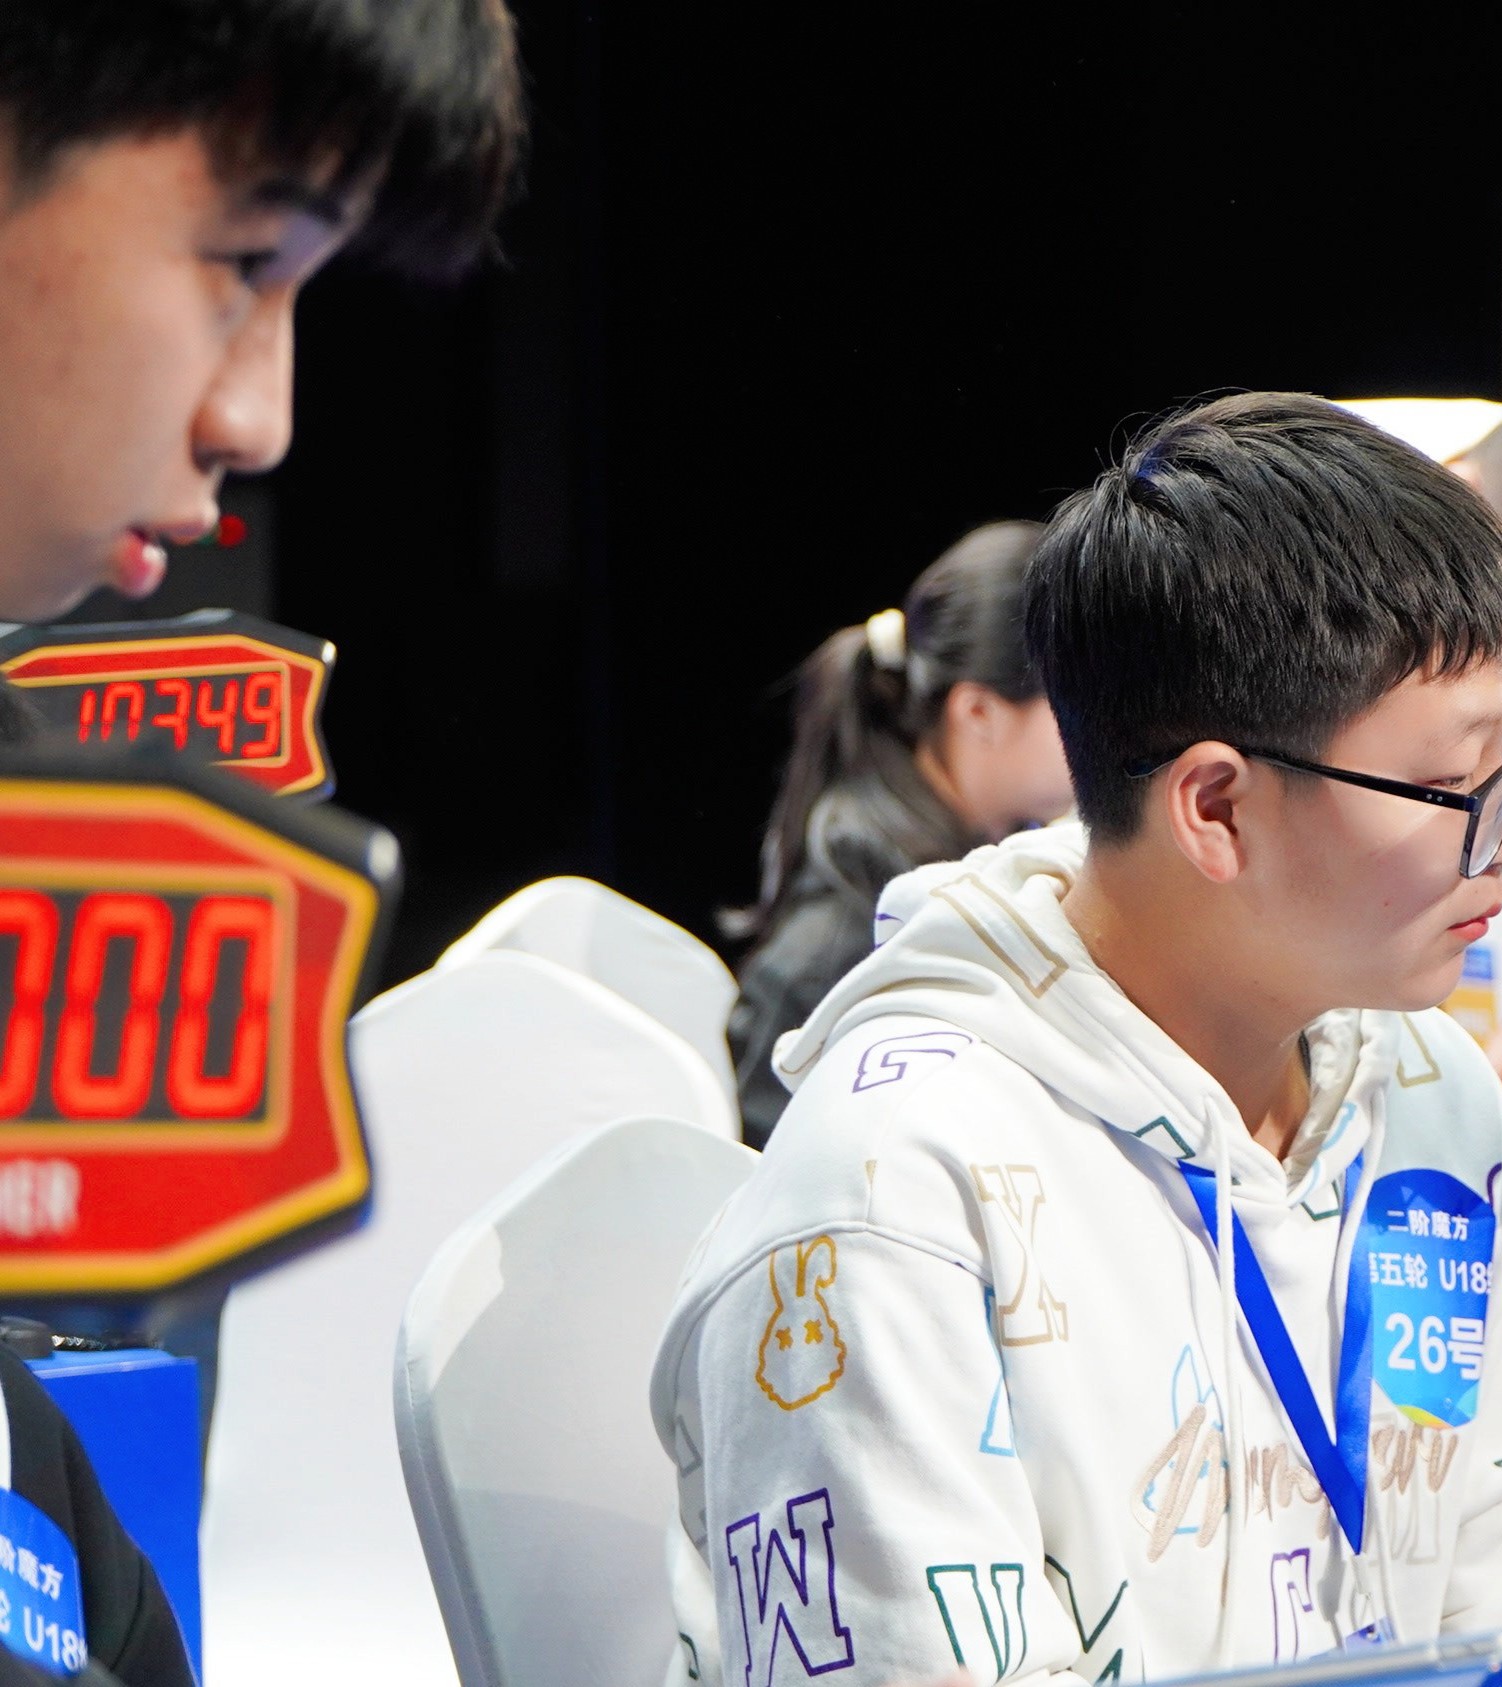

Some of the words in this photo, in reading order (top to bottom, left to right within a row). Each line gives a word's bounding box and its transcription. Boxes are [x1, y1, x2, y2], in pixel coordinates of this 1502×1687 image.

[1387, 1209, 1469, 1241] 二阶魔方
[1384, 1311, 1485, 1381] 26号
